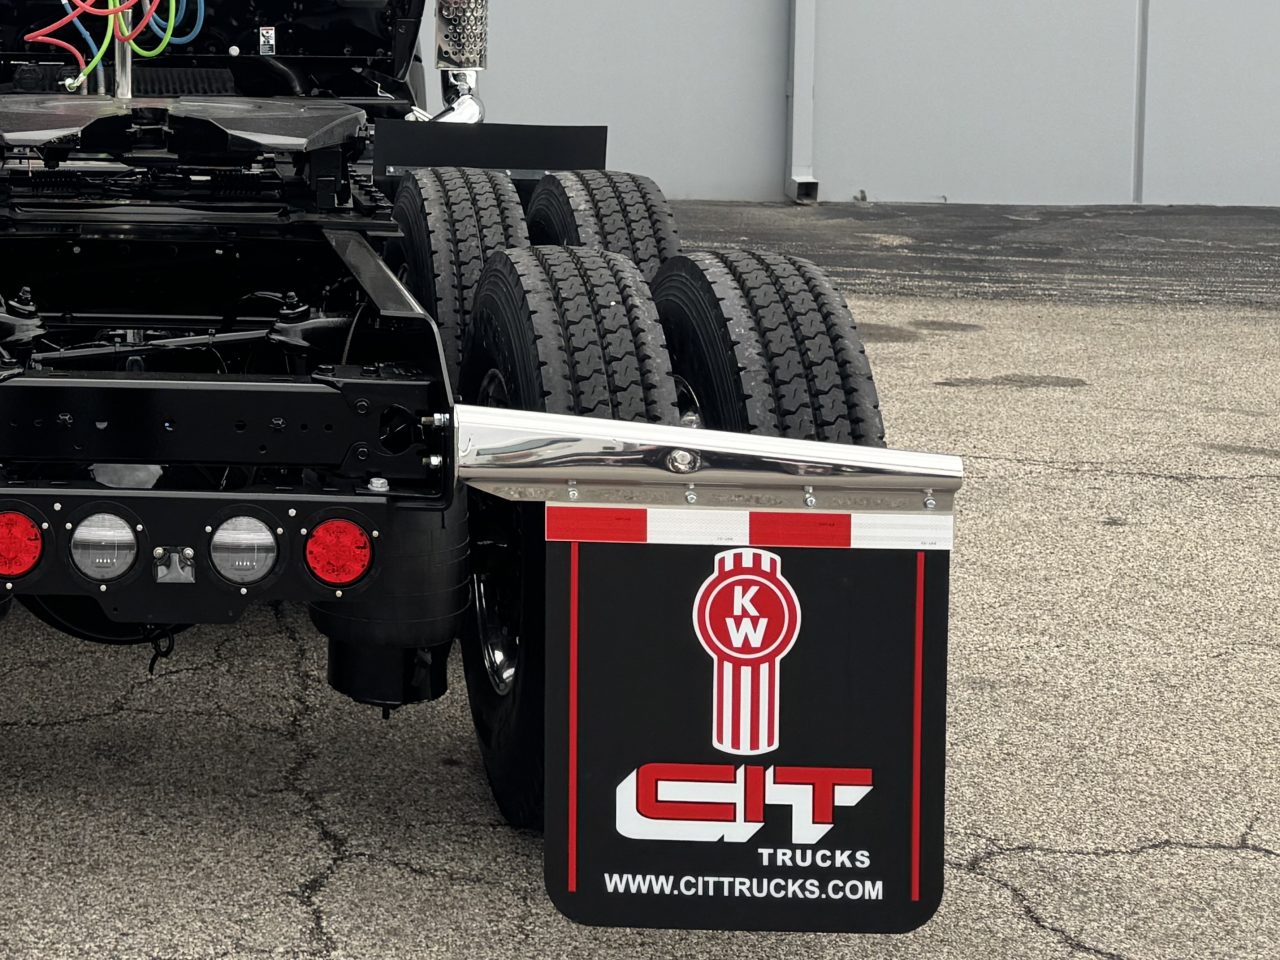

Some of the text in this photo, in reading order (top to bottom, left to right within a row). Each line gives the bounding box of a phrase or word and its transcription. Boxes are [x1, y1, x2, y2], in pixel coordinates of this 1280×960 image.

[616, 763, 874, 844] CIT
[757, 847, 871, 869] TRUCKS
[603, 873, 884, 901] WWW.CITTRUCKS.COM
